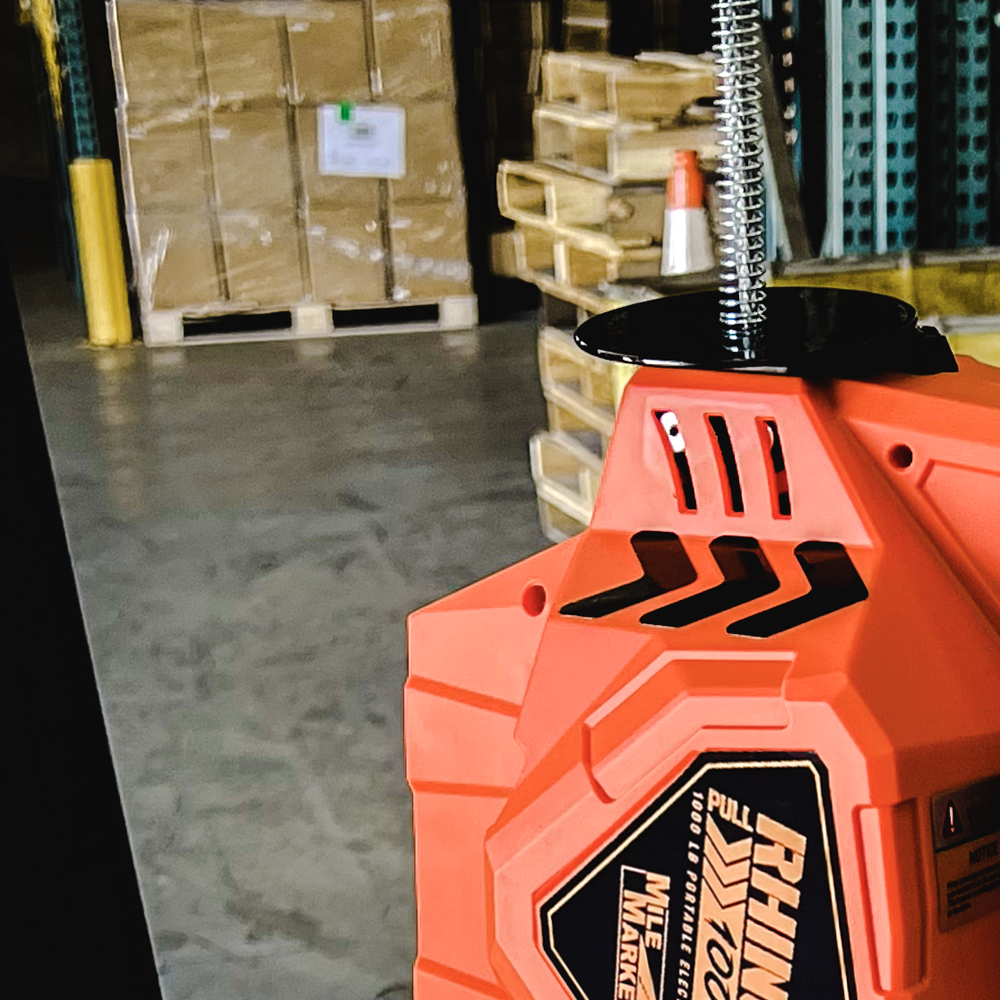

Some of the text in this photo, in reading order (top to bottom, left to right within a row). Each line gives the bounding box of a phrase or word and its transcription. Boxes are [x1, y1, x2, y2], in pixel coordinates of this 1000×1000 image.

[690, 791, 704, 835] 1000
[707, 787, 754, 833] PULL
[687, 841, 700, 864] LB
[645, 872, 671, 950] MILE
[680, 870, 698, 954] PORTABLE
